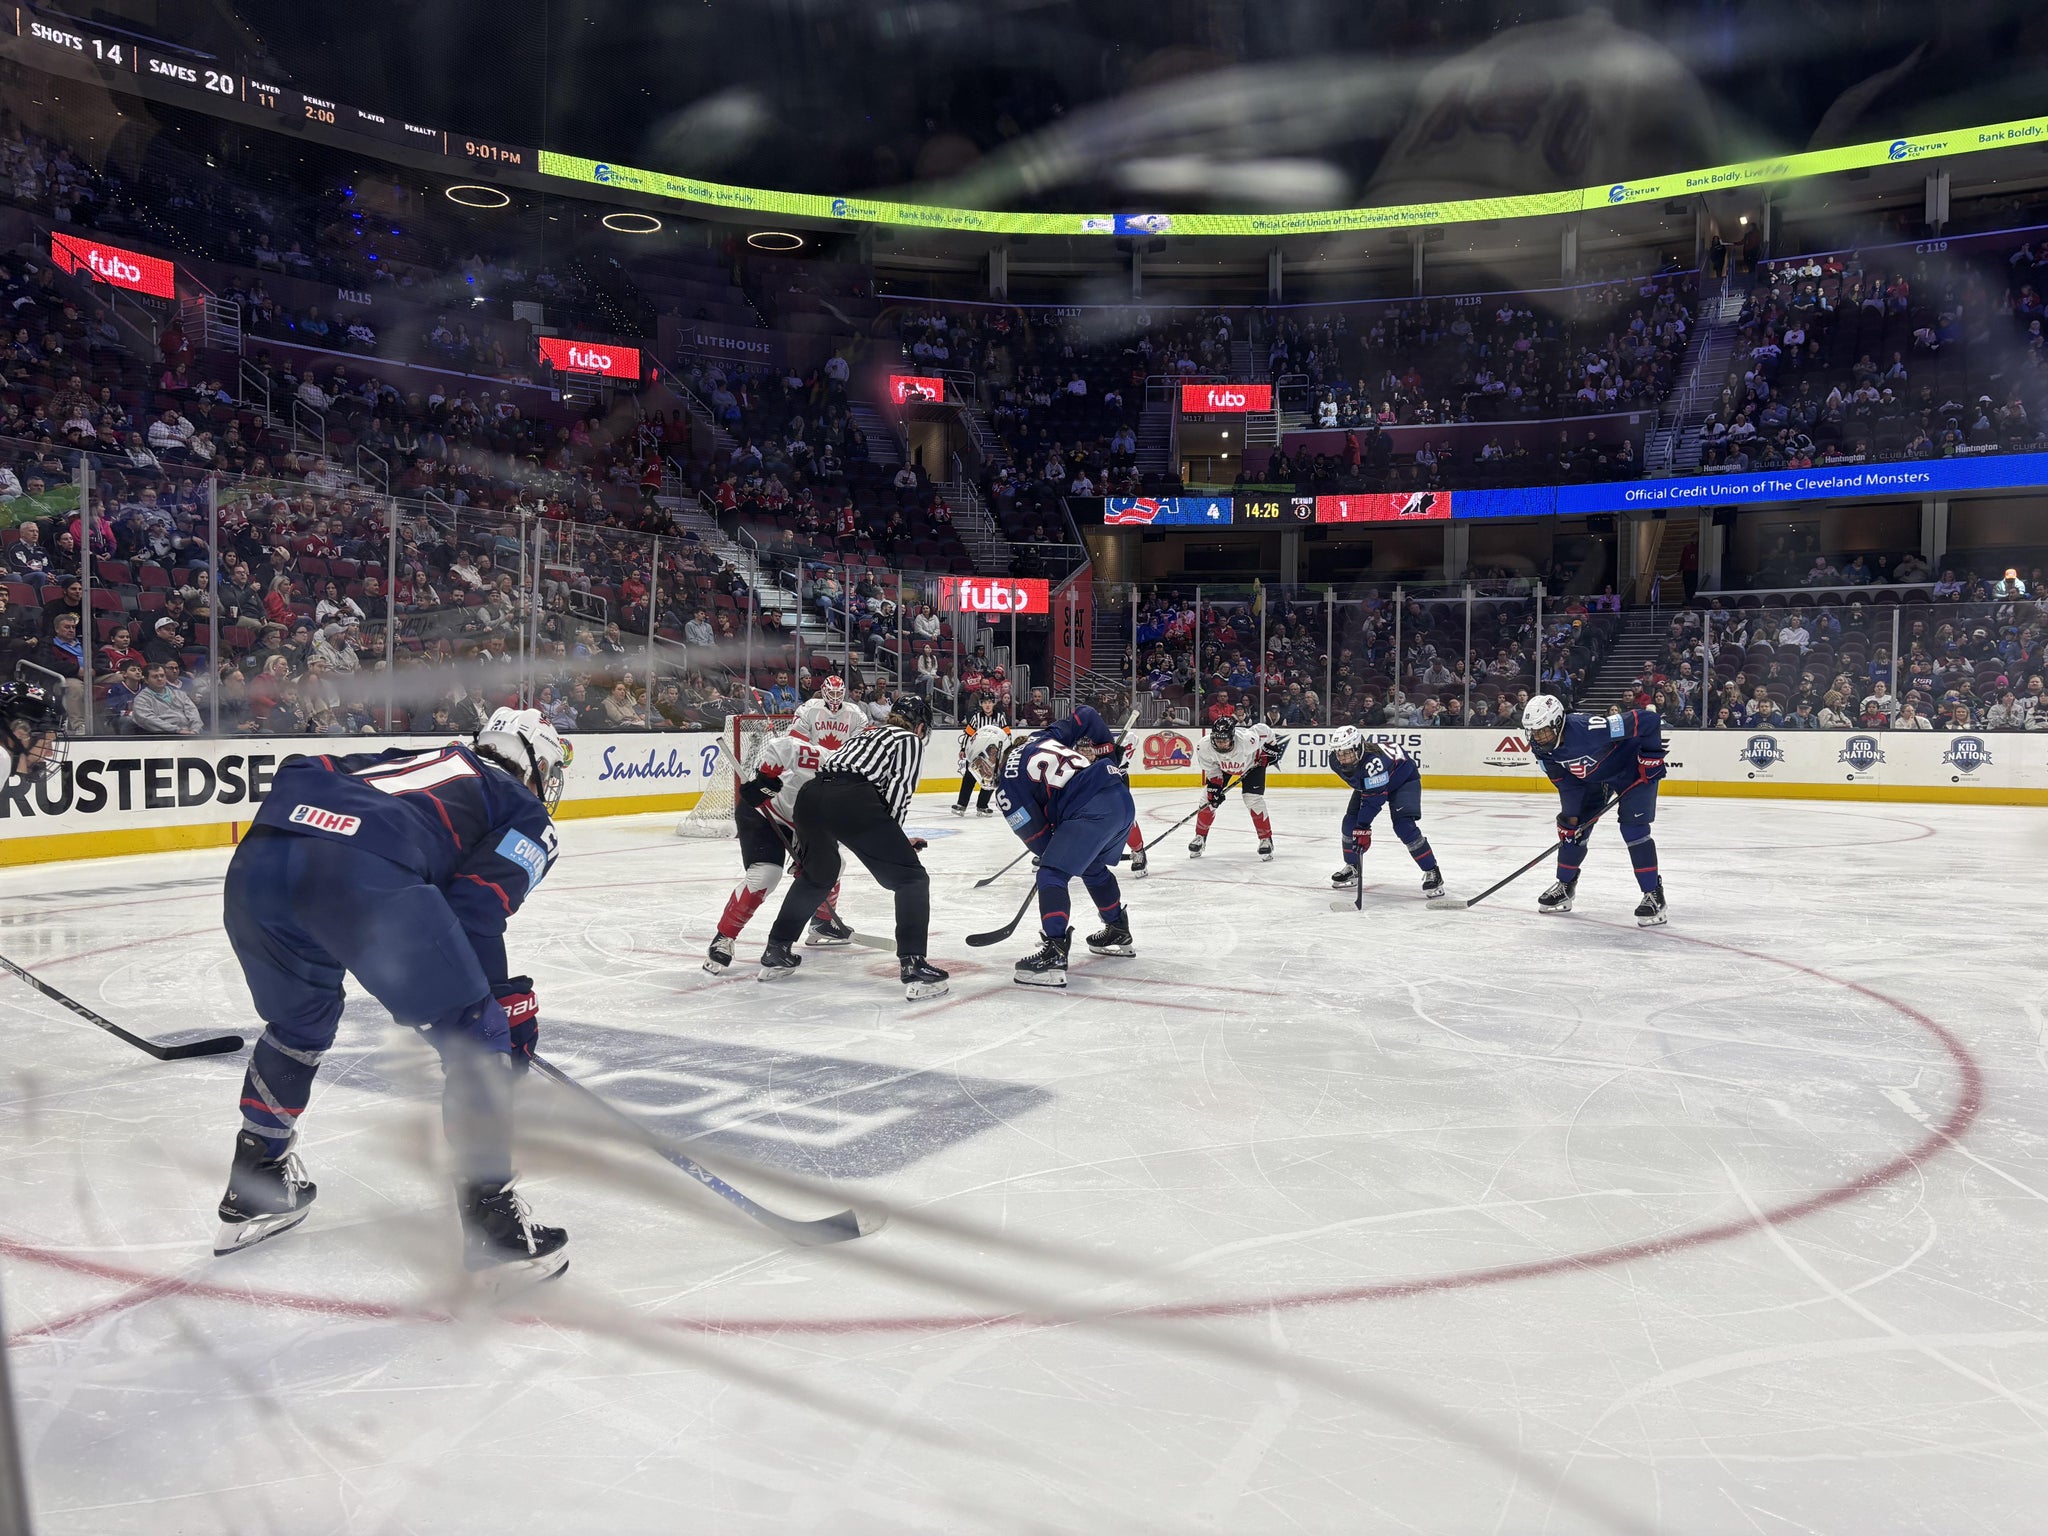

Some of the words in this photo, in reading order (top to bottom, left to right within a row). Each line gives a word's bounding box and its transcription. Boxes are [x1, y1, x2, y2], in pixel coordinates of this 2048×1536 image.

[31, 22, 83, 50] SHOTS
[92, 39, 123, 65] 14
[149, 58, 197, 83] SAVES
[204, 70, 234, 95] 20
[251, 80, 281, 95] PLAYER
[258, 93, 275, 109] 11
[303, 95, 336, 110] PENALTY
[305, 106, 335, 124] 2:00
[358, 110, 385, 124] PLAYER
[404, 123, 437, 137] PENALTY
[1979, 132, 2004, 143] Bank
[2007, 126, 2043, 138] Boldly.
[465, 141, 497, 161] 9:01
[500, 149, 521, 164] PM
[1907, 142, 1948, 153] CENTURY
[610, 173, 643, 185] CENTURY
[1686, 177, 1709, 188] Bank
[1711, 171, 1742, 183] Boldly.
[666, 182, 687, 193] Bank
[688, 186, 715, 199] Boldly.
[716, 191, 733, 200] Live
[734, 193, 756, 204] Fully.
[1625, 186, 1661, 197] CENTURY
[846, 207, 877, 216] CENTURY
[899, 211, 918, 219] Bank
[920, 213, 945, 224] Boldly.
[948, 215, 962, 223] Live
[1252, 220, 1280, 229] Official
[1281, 219, 1305, 228] Credit
[1307, 218, 1331, 227] Union
[1333, 217, 1342, 225] of
[1342, 216, 1358, 224] The
[1359, 213, 1399, 223] Cleveland
[1401, 211, 1439, 220] Monsters
[1927, 242, 1947, 253] 119
[88, 250, 141, 283] fubo
[338, 287, 372, 305] M115
[1455, 297, 1482, 307] M118
[1056, 307, 1082, 317] M117
[697, 334, 771, 354] LITEHOUSE
[568, 347, 612, 369] fubo
[898, 381, 936, 400] fbo
[1207, 390, 1246, 407] fubo
[1955, 443, 1998, 453] Huntington
[1825, 454, 1866, 464] Huntington
[1703, 463, 1741, 473] Huntington
[1626, 488, 1667, 501] Official
[1670, 485, 1707, 499] Credit
[1711, 483, 1749, 495] Union
[1752, 481, 1767, 493] of
[1768, 479, 1793, 491] The
[1796, 475, 1862, 490] Cleveland
[1865, 471, 1930, 485] Monsters
[1291, 497, 1313, 505] PERIOD
[1207, 503, 1220, 520] 4
[1245, 502, 1279, 519] 14:26
[1299, 508, 1306, 517] 3
[960, 579, 1028, 611] fubo
[1064, 607, 1085, 628] SAT
[1063, 628, 1085, 648] GEK
[814, 720, 849, 734] CANADA
[1587, 716, 1607, 731] 10
[1298, 733, 1422, 746] COMBUS
[1754, 741, 1771, 750] KID
[1852, 742, 1871, 751] KID
[1745, 749, 1779, 758] NATION
[1843, 750, 1880, 760] NATION
[1958, 743, 1977, 752] KID
[598, 745, 691, 781] Sandals
[1948, 751, 1987, 761] NATION
[1365, 757, 1384, 777] 23
[0, 753, 306, 819] RUSTEDSE
[306, 809, 356, 831] IIHF
